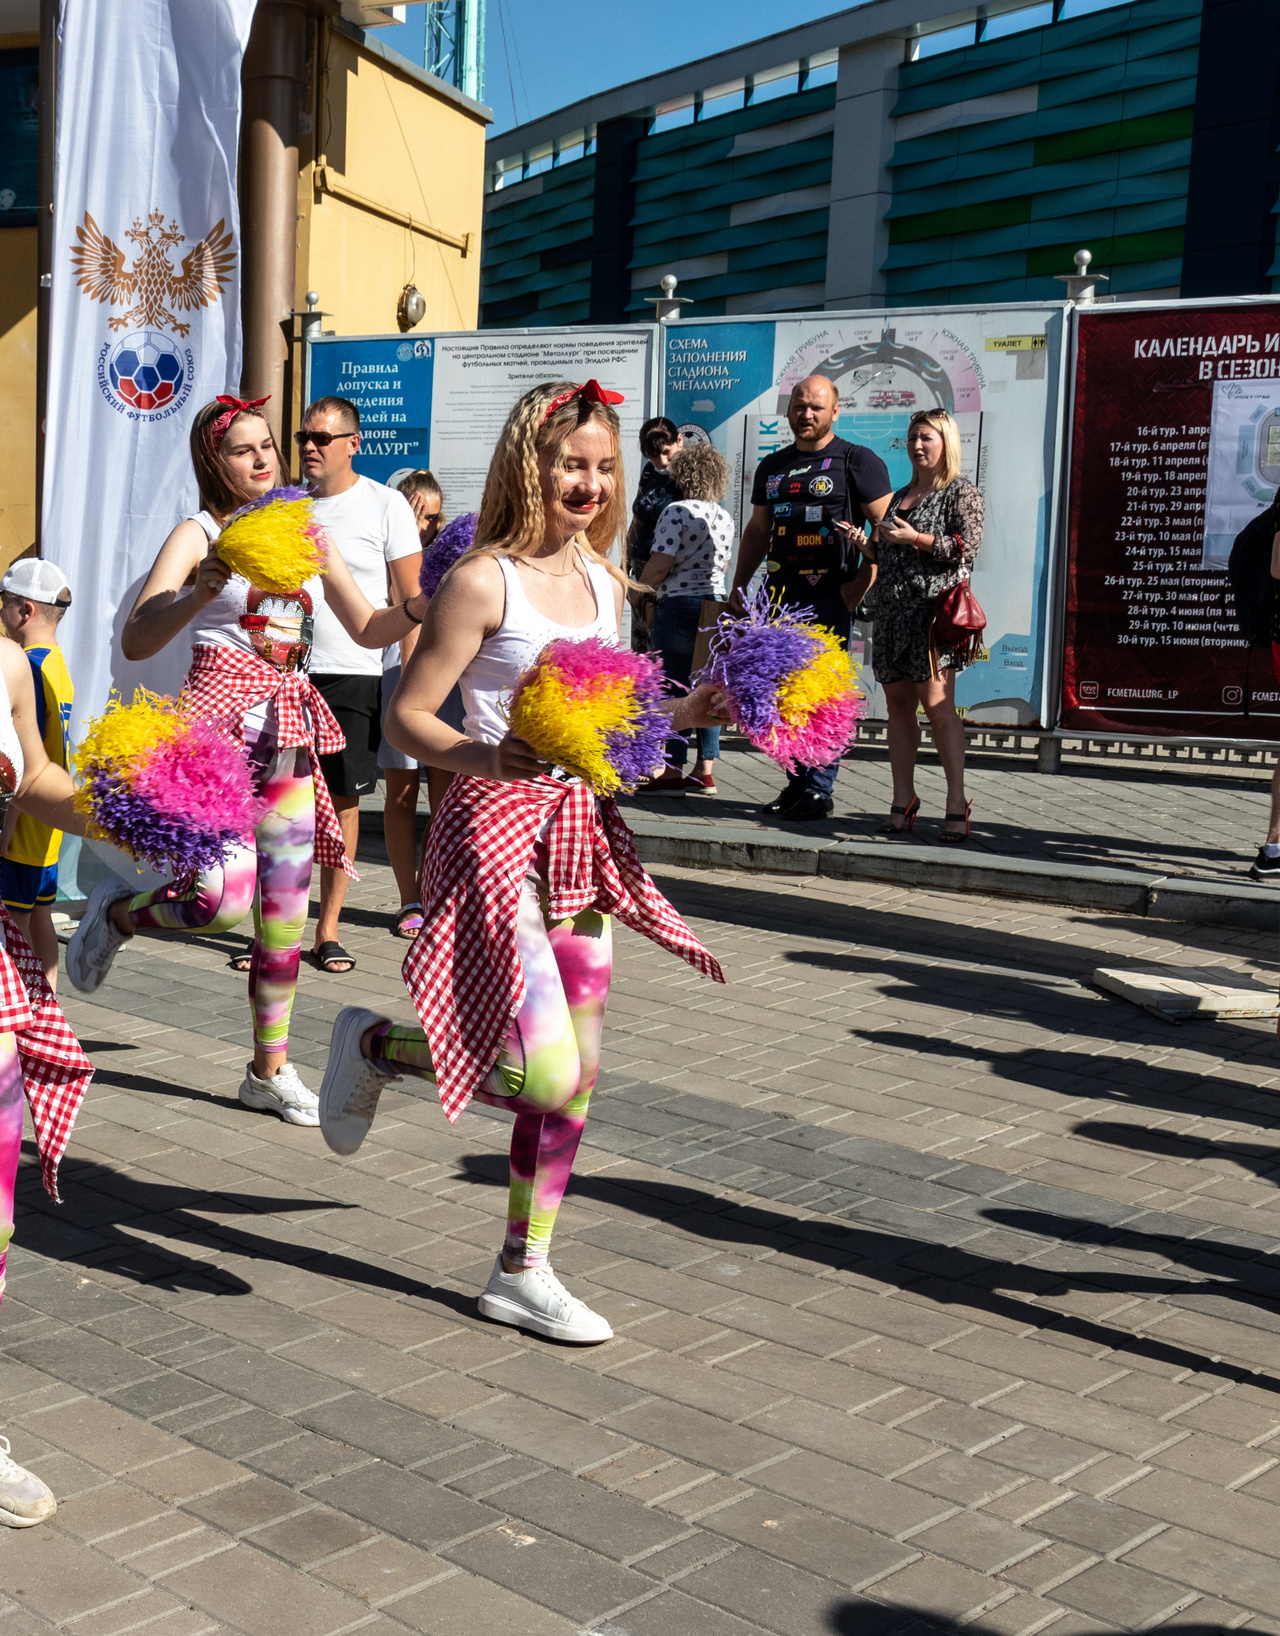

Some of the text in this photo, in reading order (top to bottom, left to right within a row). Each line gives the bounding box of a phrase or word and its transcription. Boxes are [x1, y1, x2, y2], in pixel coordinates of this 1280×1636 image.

[669, 338, 708, 350] СХЕМА
[993, 340, 1022, 348] ТУАЛЕТ
[1134, 334, 1260, 358] КАЛЕНДАРЬ
[669, 351, 747, 363] ЗАПОЛНЕНИЯ
[941, 328, 986, 390] ЮЖНАЯ ТРИБУНА
[341, 361, 398, 378] Правила
[668, 366, 729, 379] СТАДИОНА
[1199, 361, 1213, 380] В
[98, 342, 194, 422] РОССИЙСКИЙ ФУТБОЛЬНЫЙ СОЮЗ
[336, 380, 401, 394] допуска и
[346, 396, 404, 408] ведения
[391, 413, 407, 423] на
[1137, 426, 1157, 436] 16-й
[1160, 428, 1179, 437] тур.
[1181, 425, 1186, 435] 1
[1110, 441, 1195, 453] 17-й тур. 6 апреля
[1109, 457, 1129, 467] 18-й
[1131, 458, 1150, 468] тур.
[1152, 456, 1163, 466] 11
[1165, 457, 1200, 468] апреля
[1121, 472, 1140, 482] 19-й
[1143, 473, 1162, 483] тур.
[1164, 471, 1175, 480] 18
[1127, 486, 1147, 496] 20-й
[1149, 487, 1168, 498] тур.
[1170, 486, 1181, 496] 23
[1127, 502, 1147, 511] 21-й
[1149, 503, 1168, 513] тур.
[1170, 501, 1181, 511] 29
[1121, 516, 1191, 528] 22-й тур. 3 мая
[797, 535, 821, 546] BOOM
[1115, 531, 1191, 543] 23-й тур. 10 мая
[1125, 546, 1201, 558] 24-й тур. 15 мая
[1133, 561, 1153, 571] 25-й
[1176, 561, 1187, 571] 21
[1104, 575, 1125, 585] 26-й
[1126, 577, 1145, 587] тур.
[1147, 576, 1158, 586] 25
[1160, 577, 1179, 586] мая
[1122, 591, 1198, 602] 27-й тур. 30 мая
[1127, 605, 1204, 617] 28-й тур. 4 июня
[1129, 620, 1149, 630] 29-й
[1151, 621, 1170, 632] тур.
[1172, 621, 1183, 630] 10
[1185, 622, 1211, 631] июня
[1117, 635, 1138, 644] 30-й
[1139, 636, 1158, 647] тур.
[1161, 635, 1171, 645] 15
[1173, 637, 1199, 646] июня
[1002, 645, 1028, 653] Выход
[1004, 659, 1023, 667] Вход
[1107, 688, 1179, 700] FCMETALLURG_LP
